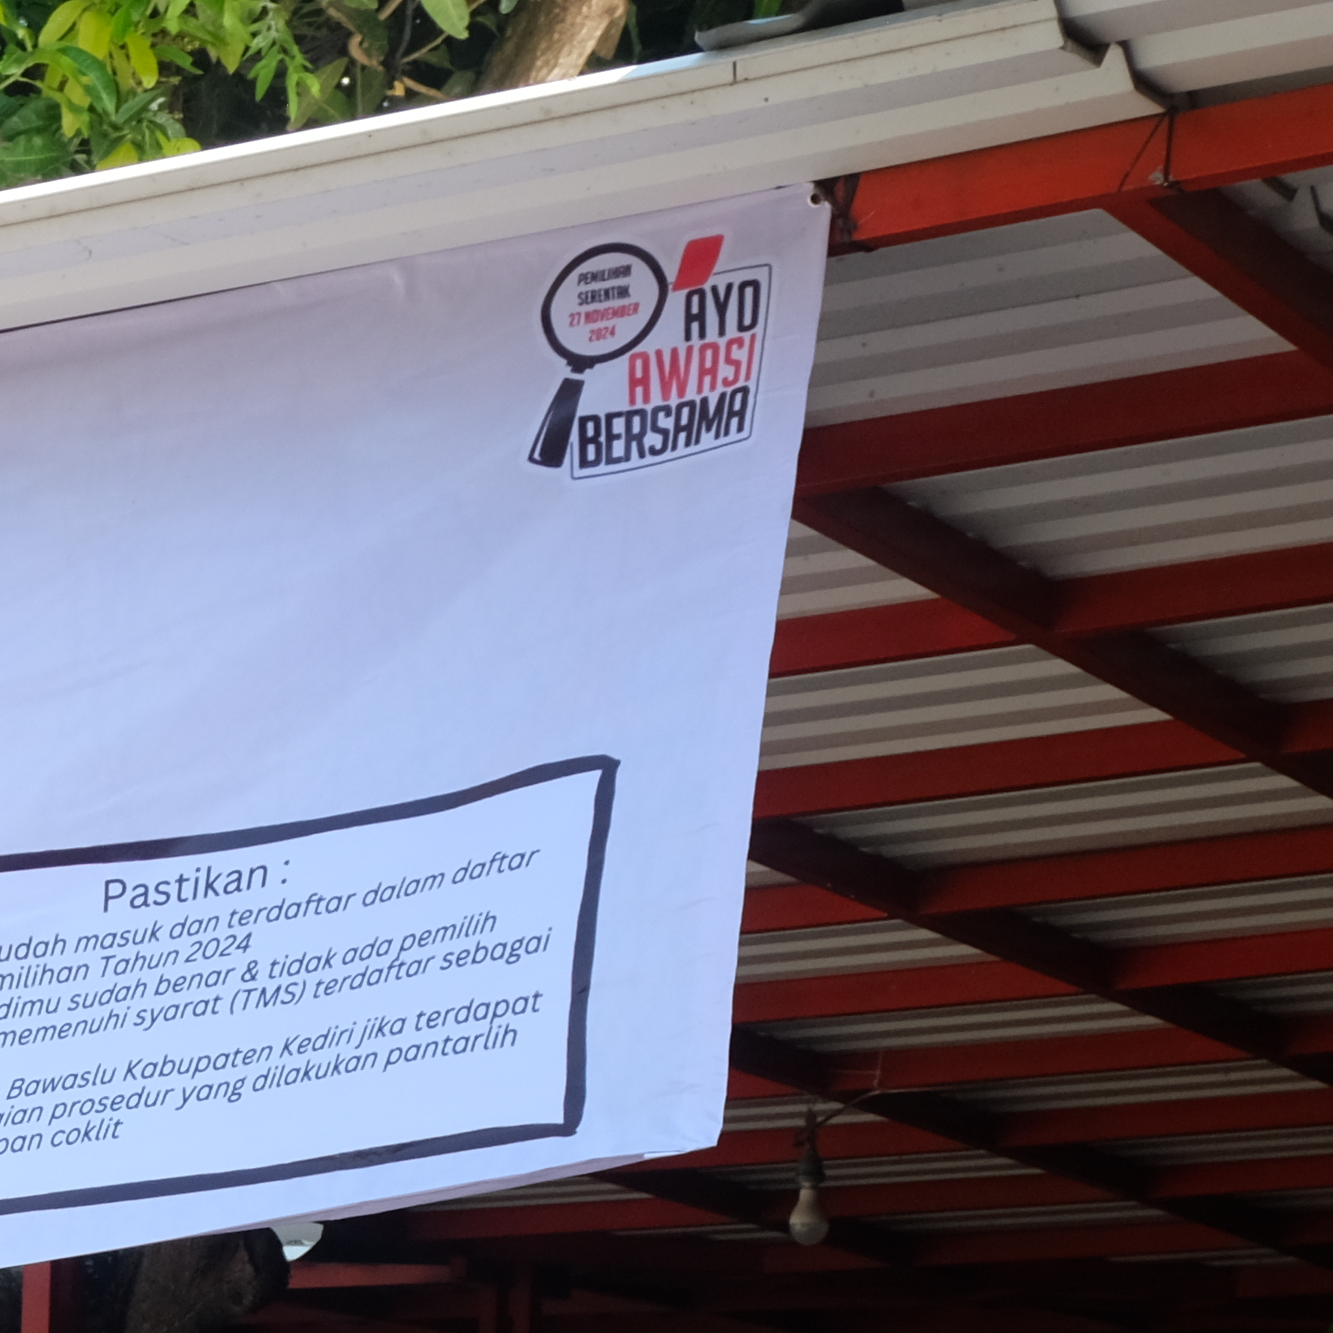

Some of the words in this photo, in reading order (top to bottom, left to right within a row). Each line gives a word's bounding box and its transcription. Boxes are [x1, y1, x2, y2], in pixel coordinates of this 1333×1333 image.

[577, 285, 631, 306] SERENTAK
[584, 302, 640, 326] NOVEMBER
[684, 279, 761, 342] AYO
[628, 333, 757, 407] AWASI
[578, 385, 751, 470] BERSAMA
[74, 920, 164, 953] masuk
[169, 914, 220, 940] dan
[227, 892, 357, 929] terdaftar
[362, 871, 446, 908] dalam
[451, 849, 541, 886] daftar
[102, 862, 269, 913] Pastikan
[280, 859, 290, 885] :
[67, 978, 148, 1012] sudah
[153, 967, 236, 998] benar
[240, 959, 260, 984] &
[267, 948, 337, 980] tidak
[341, 936, 394, 967] ada
[397, 910, 498, 960] pemilih
[99, 947, 181, 978] Tahun
[183, 932, 254, 964] 2024
[133, 994, 223, 1034] syarat
[229, 979, 308, 1016] (TMS)
[313, 955, 436, 1000] terdaftar
[439, 927, 554, 972] sebagai
[5, 1064, 117, 1101] Bawaslu
[122, 1044, 274, 1083] Kabupaten
[279, 1020, 358, 1058] Kediri
[354, 1013, 407, 1050] jika
[414, 990, 544, 1032] terdapat
[48, 1083, 174, 1126] prosedur
[174, 1075, 248, 1112] yang
[251, 1050, 379, 1093] dilakukan
[382, 1022, 520, 1073] pantarlih
[49, 1117, 124, 1148] coklit
